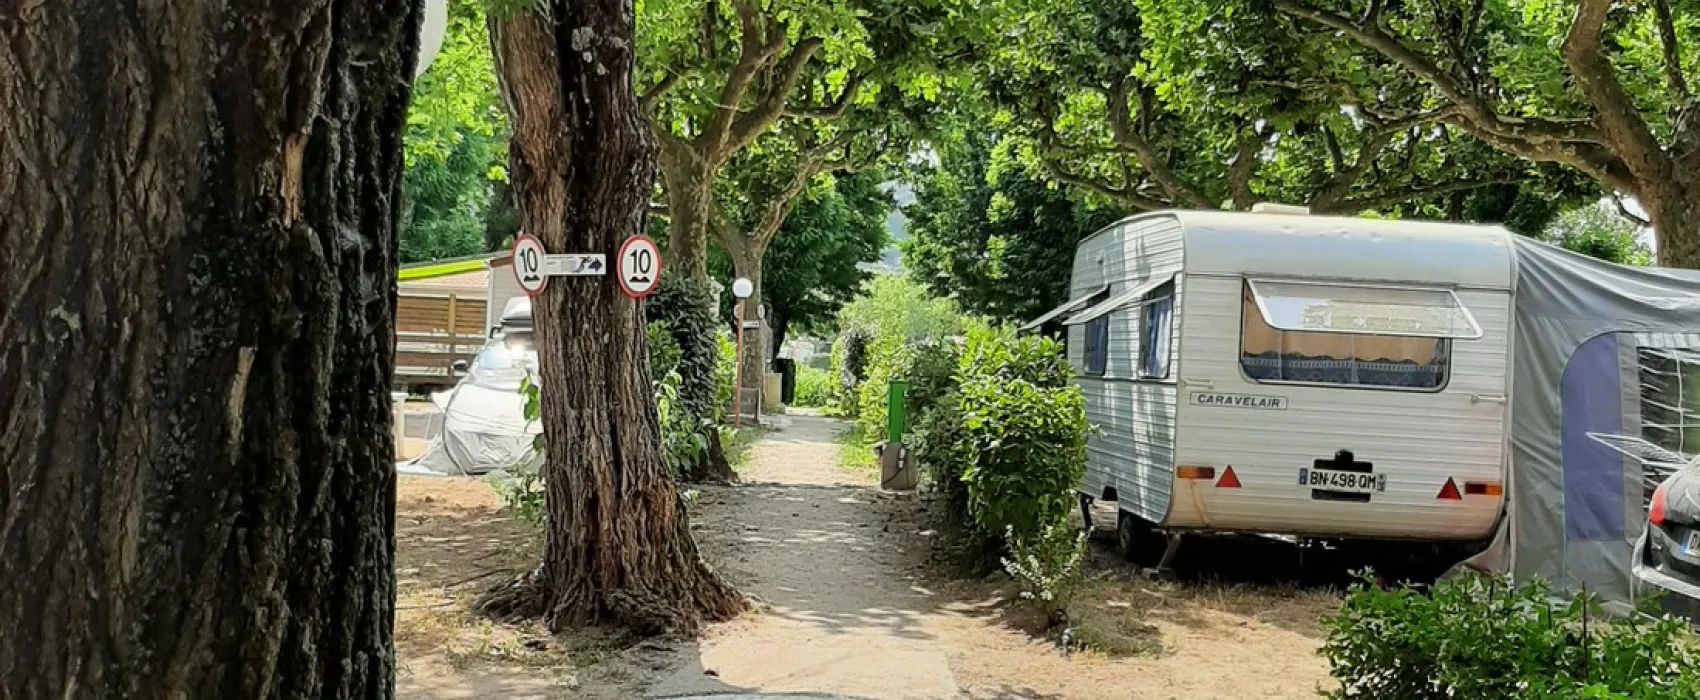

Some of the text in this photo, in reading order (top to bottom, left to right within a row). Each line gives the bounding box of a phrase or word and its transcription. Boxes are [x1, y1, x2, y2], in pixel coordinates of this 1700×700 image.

[519, 247, 539, 273] 10
[629, 248, 651, 275] 10
[1197, 394, 1281, 408] CARAVELAIR
